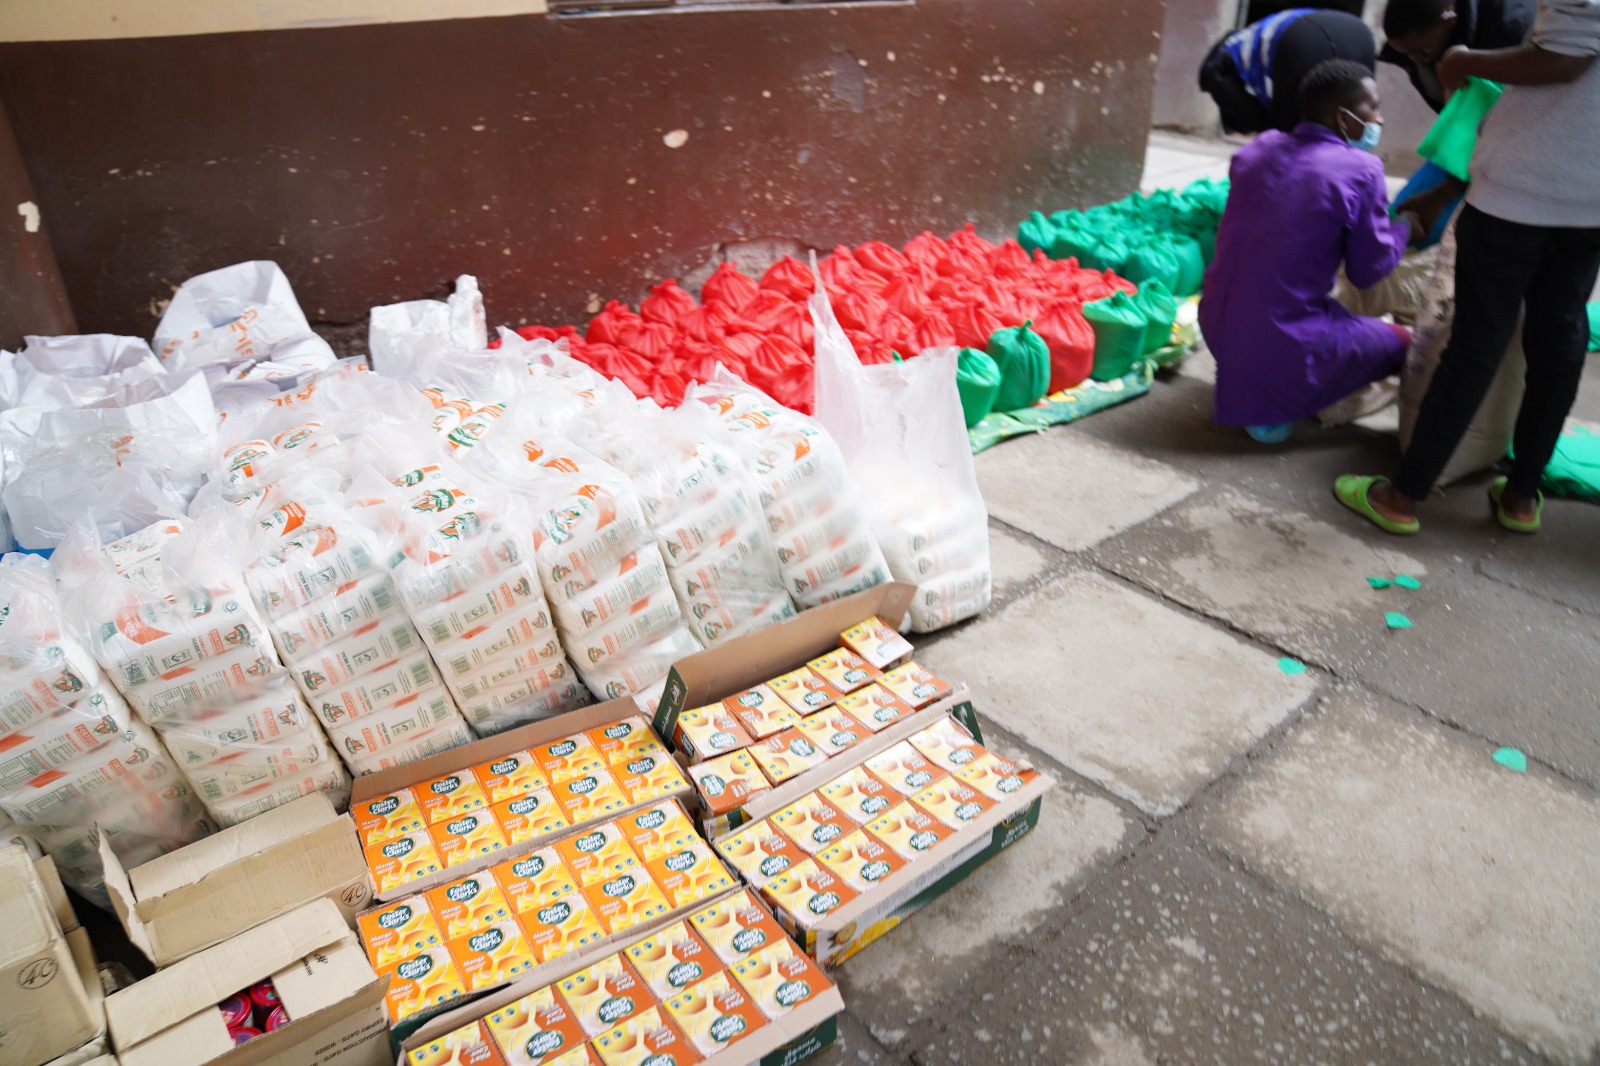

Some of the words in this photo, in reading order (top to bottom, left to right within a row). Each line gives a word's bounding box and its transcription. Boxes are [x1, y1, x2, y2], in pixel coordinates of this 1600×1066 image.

[607, 722, 629, 733] Foster
[551, 741, 572, 752] Foster
[493, 759, 515, 770] Foster
[629, 758, 651, 769] Foster
[434, 778, 456, 789] Foster
[571, 778, 593, 788] Foster
[372, 798, 395, 809] Foster
[511, 798, 534, 809] Foster
[638, 811, 661, 823] Foster
[450, 818, 473, 830] Foster
[577, 833, 602, 846] Foster
[385, 840, 410, 852] Foster
[515, 857, 540, 871] Foster
[667, 852, 691, 865] Foster
[449, 881, 474, 895] Foster
[605, 877, 629, 891] Foster
[381, 907, 407, 921] Foster
[540, 903, 565, 918] Foster
[471, 930, 498, 945] Foster
[400, 956, 428, 972] Foster
